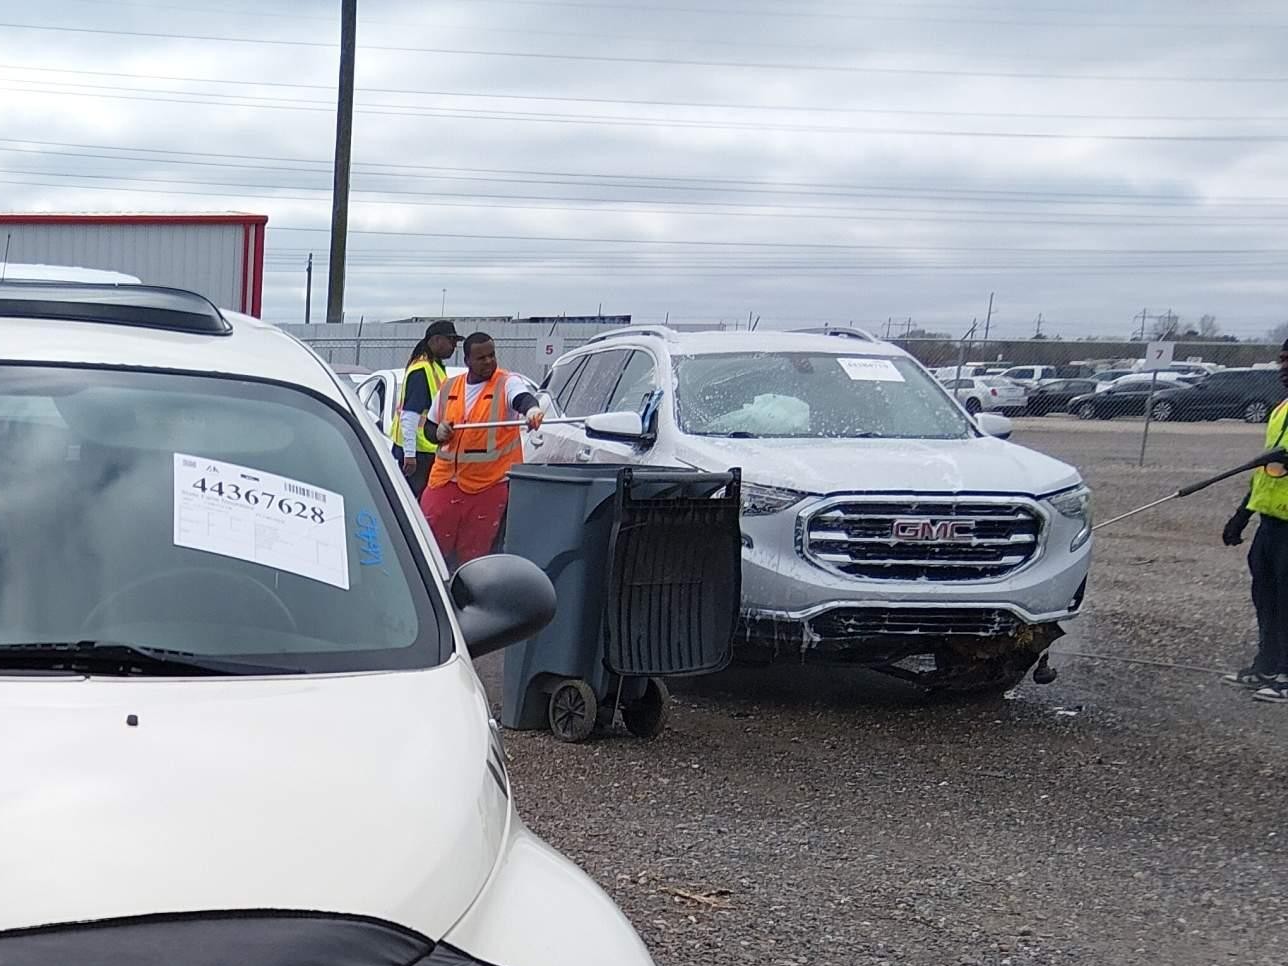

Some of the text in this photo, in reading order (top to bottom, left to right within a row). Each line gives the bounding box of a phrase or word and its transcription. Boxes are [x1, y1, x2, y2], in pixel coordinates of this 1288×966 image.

[545, 345, 554, 355] 5
[1155, 349, 1164, 360] 7
[192, 477, 326, 525] 44367628
[893, 519, 976, 541] GMC
